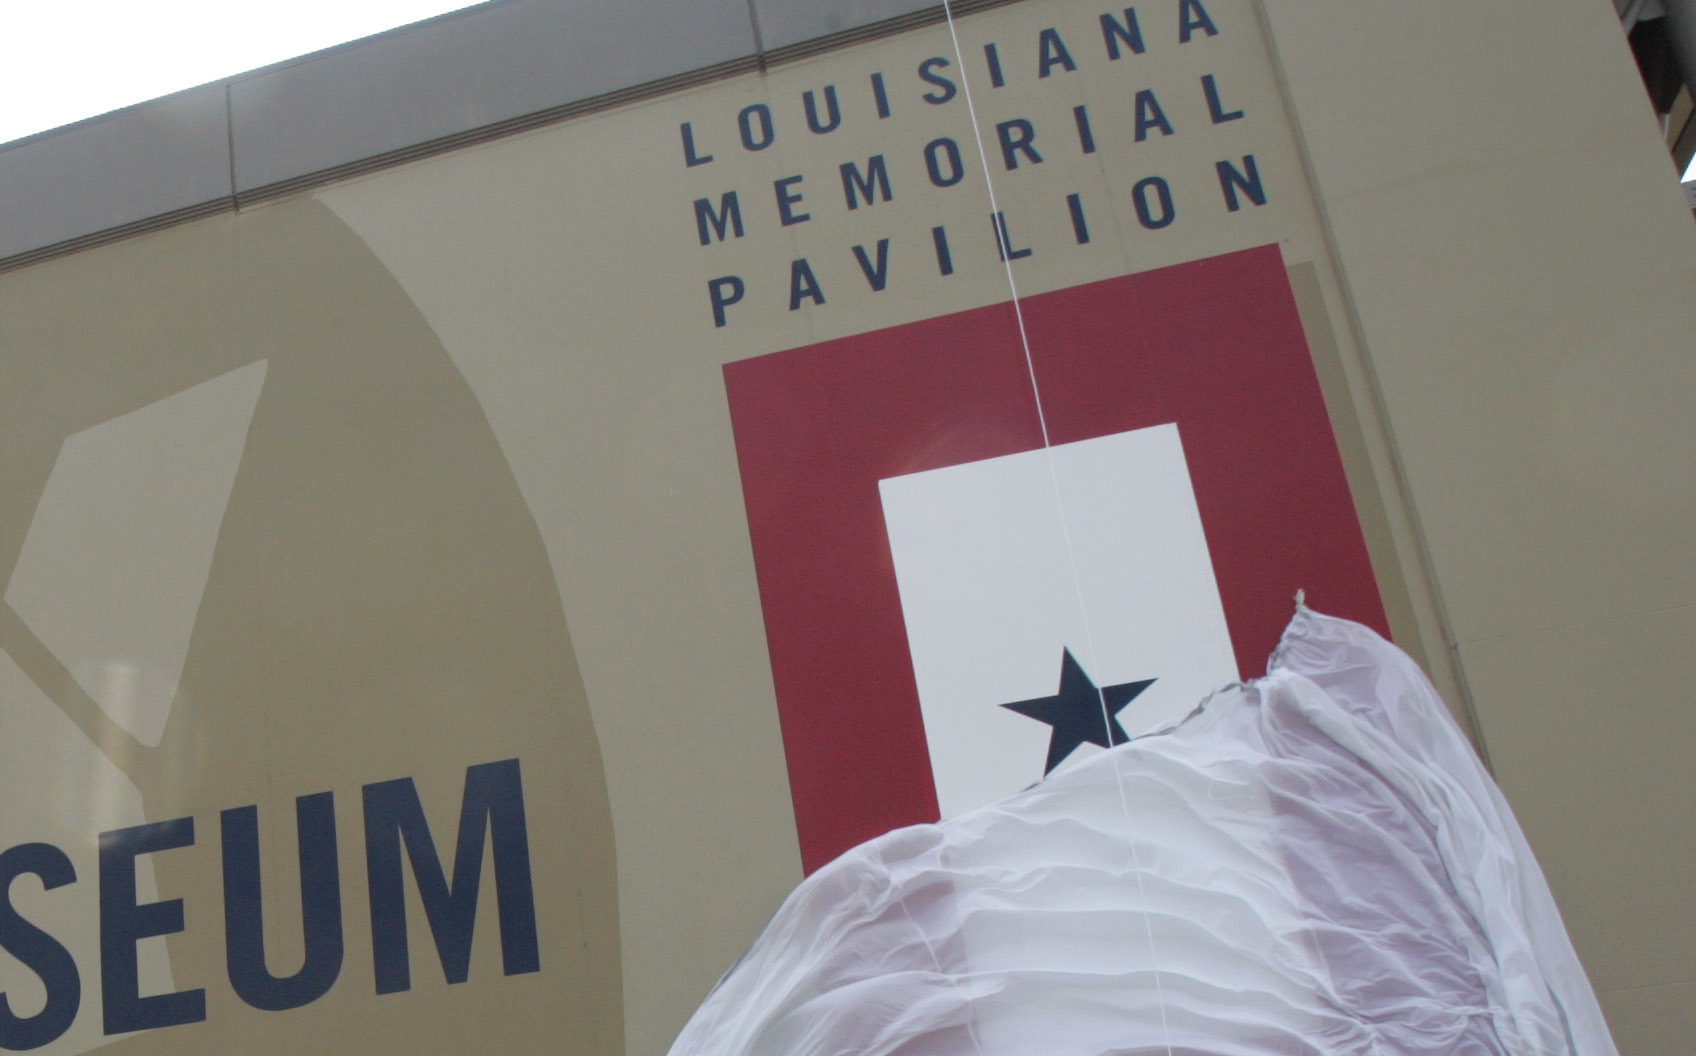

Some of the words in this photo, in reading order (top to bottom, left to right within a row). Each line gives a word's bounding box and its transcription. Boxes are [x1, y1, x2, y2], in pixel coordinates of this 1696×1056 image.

[679, 0, 1219, 168] LOUISIANA
[692, 73, 1244, 246] MEMORIAL
[706, 153, 1268, 328] PAVILION
